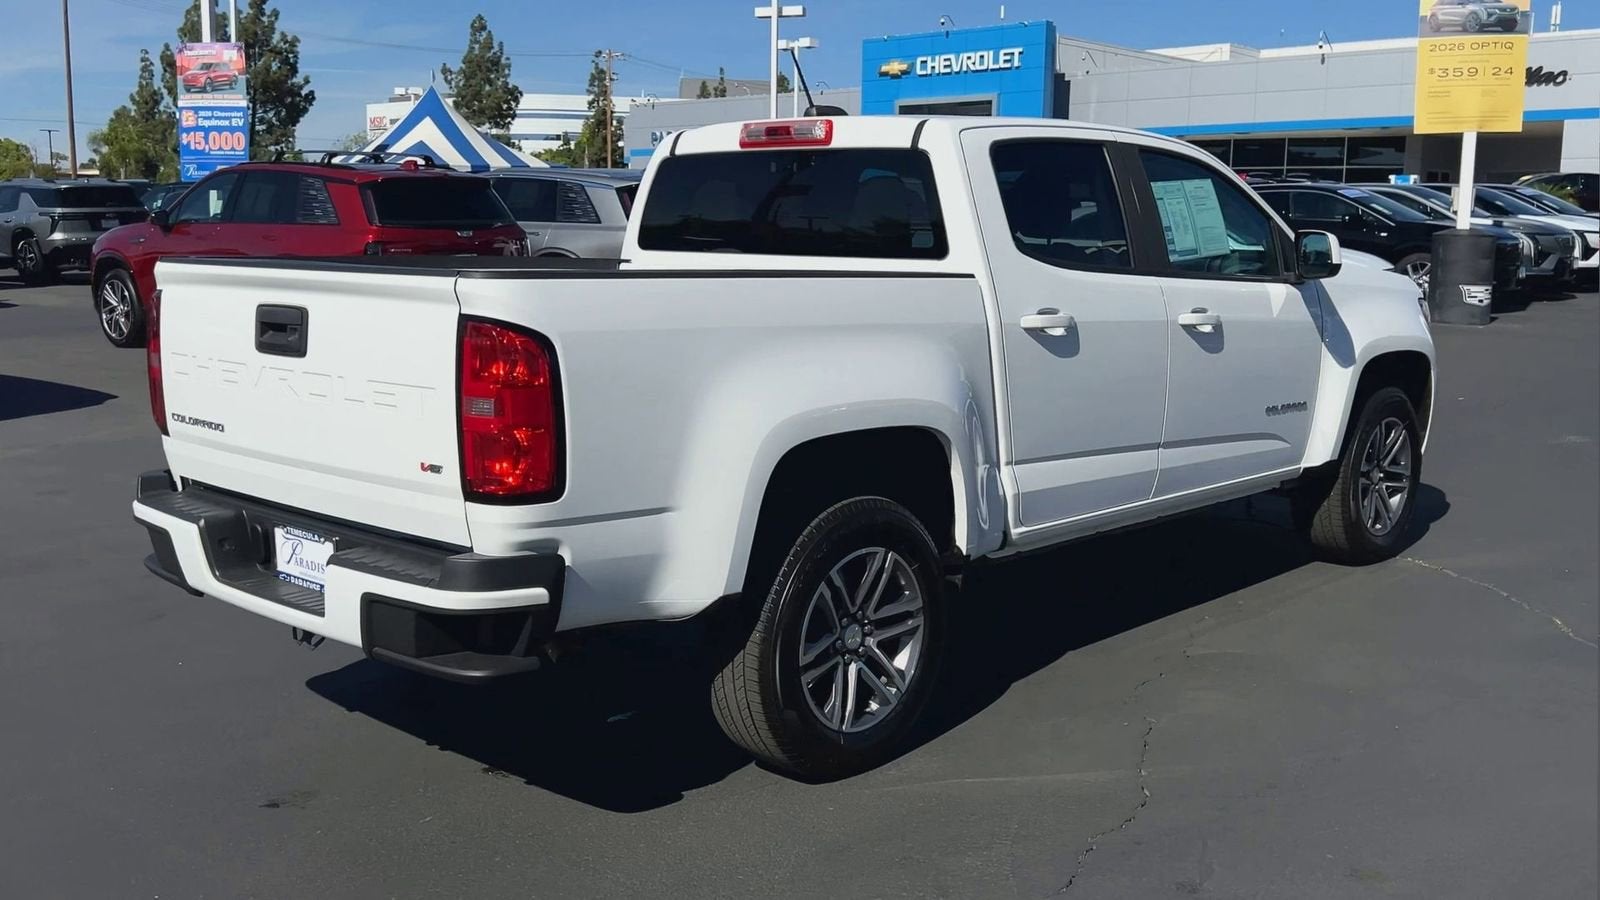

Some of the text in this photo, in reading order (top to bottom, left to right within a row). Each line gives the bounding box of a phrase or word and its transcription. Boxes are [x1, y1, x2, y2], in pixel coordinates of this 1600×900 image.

[1429, 41, 1514, 52] 2026 OPTIQ
[916, 48, 1023, 75] CHEVROLET
[1428, 66, 1514, 78] $359 24
[198, 117, 244, 128] Equinox EV
[181, 131, 245, 153] $15,000
[651, 131, 672, 147] PA
[170, 351, 436, 419] CHEVROLET
[171, 412, 225, 433] COLORADO
[286, 526, 320, 542] TEMECULA
[280, 534, 326, 575] PARADIS
